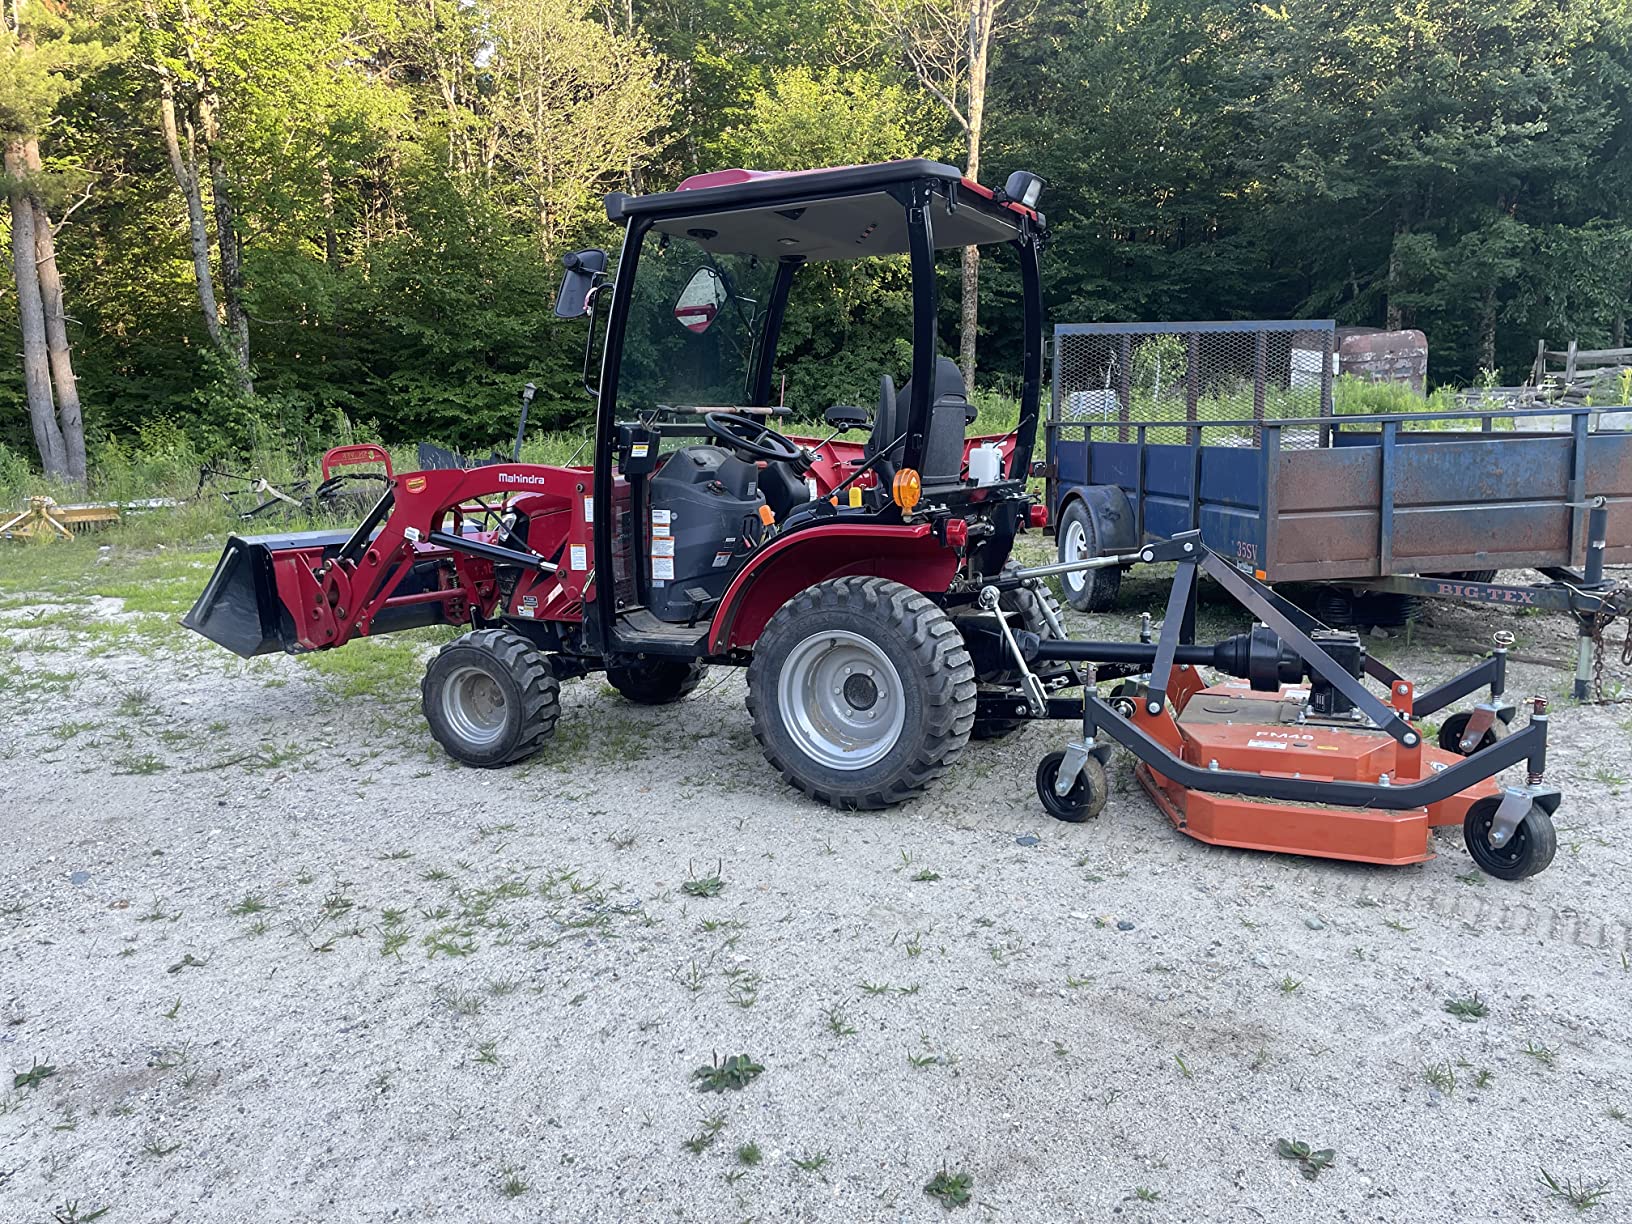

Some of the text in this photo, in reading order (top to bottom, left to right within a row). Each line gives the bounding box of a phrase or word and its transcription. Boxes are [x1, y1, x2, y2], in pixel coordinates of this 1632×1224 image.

[498, 472, 545, 485] Mahindra
[1236, 540, 1258, 561] 35SV
[1437, 583, 1535, 604] BIG-TEX
